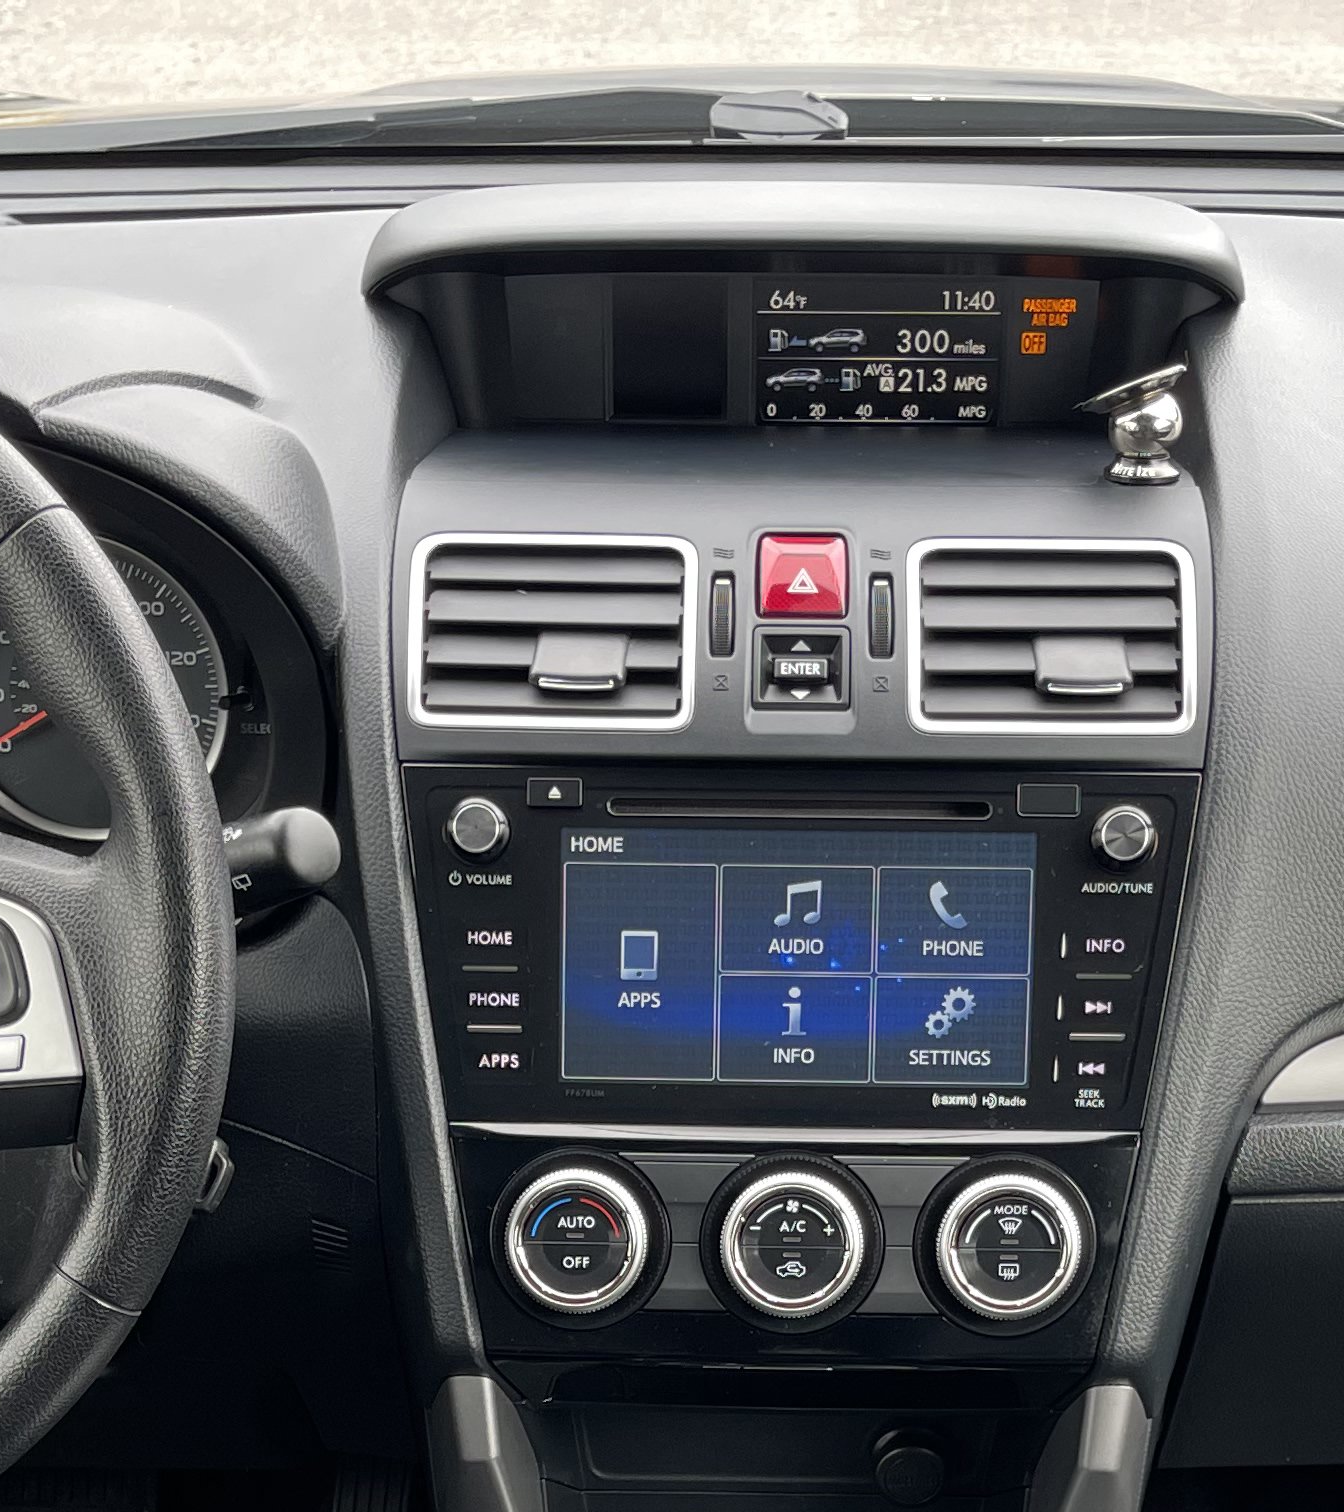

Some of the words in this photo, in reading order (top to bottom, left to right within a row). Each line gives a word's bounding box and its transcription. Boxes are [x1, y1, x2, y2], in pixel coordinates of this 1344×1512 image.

[942, 290, 995, 311] 11:40
[1022, 298, 1077, 313] PASSENGER
[896, 329, 950, 354] 300
[953, 339, 986, 354] miles
[1022, 333, 1046, 353] OFF
[897, 368, 947, 392] 21.3
[954, 376, 988, 392] MPG
[766, 404, 777, 416] 0
[808, 404, 826, 416] 20
[855, 404, 873, 416] 40
[901, 404, 919, 417] 60
[958, 405, 987, 418] MPG
[779, 661, 822, 676] ENTER
[20, 703, 38, 714] 20
[570, 836, 625, 853] HOME
[465, 873, 513, 886] VOLUME
[1081, 882, 1154, 895] AUDIO/TUNE
[467, 930, 513, 946] HOME
[1085, 938, 1125, 953] INFO
[768, 938, 825, 956] AUDIO
[922, 939, 984, 957] PHONE
[468, 992, 520, 1007] PHONE
[617, 992, 661, 1009] APPS
[478, 1054, 520, 1069] APPS
[773, 1047, 815, 1065] INFO
[908, 1049, 991, 1067] SETTINGS
[998, 1096, 1027, 1107] Radio
[1078, 1089, 1100, 1099] SEEK
[1074, 1098, 1105, 1108] TRACK
[993, 1204, 1029, 1216] MODE
[557, 1215, 596, 1229] AUTO
[778, 1219, 808, 1233] A/C
[562, 1255, 591, 1269] OFF
